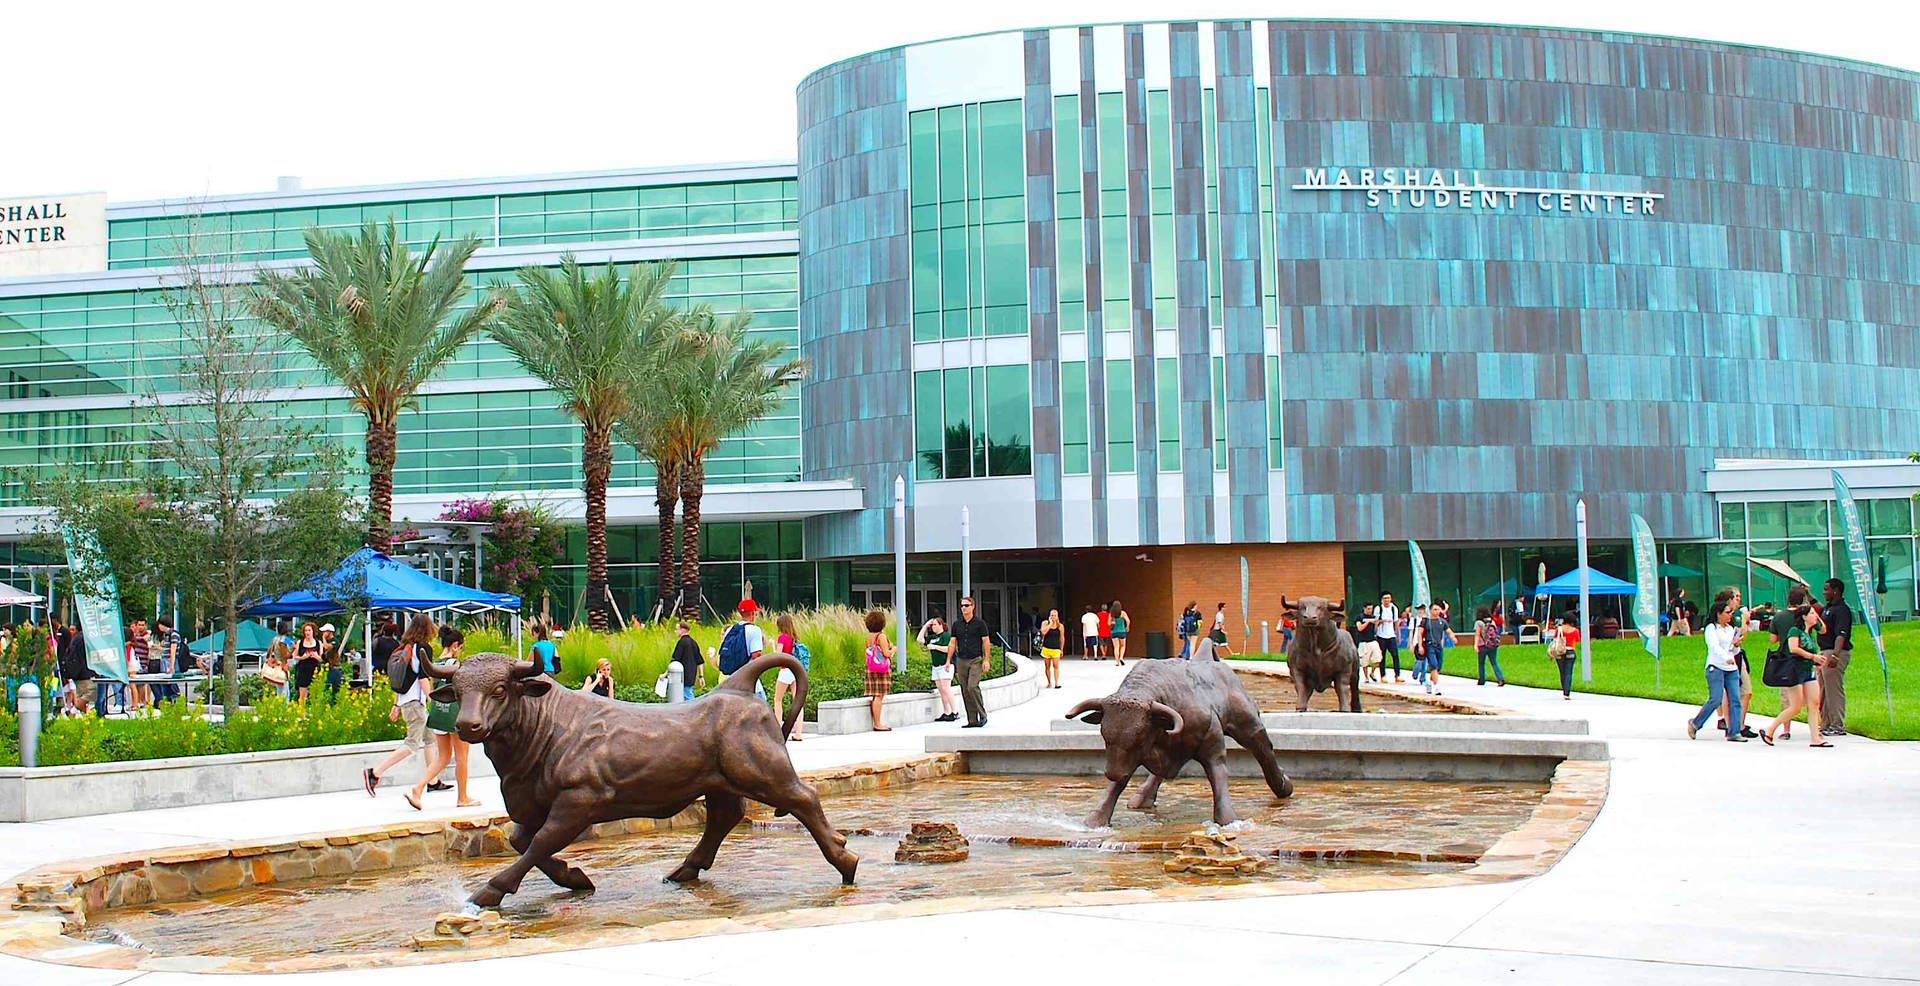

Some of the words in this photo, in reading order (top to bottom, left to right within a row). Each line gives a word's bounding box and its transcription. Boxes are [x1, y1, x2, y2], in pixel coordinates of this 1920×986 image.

[1305, 168, 1485, 188] MARSHALL
[1366, 189, 1518, 209] STUDENT
[1537, 193, 1656, 215] CENTER
